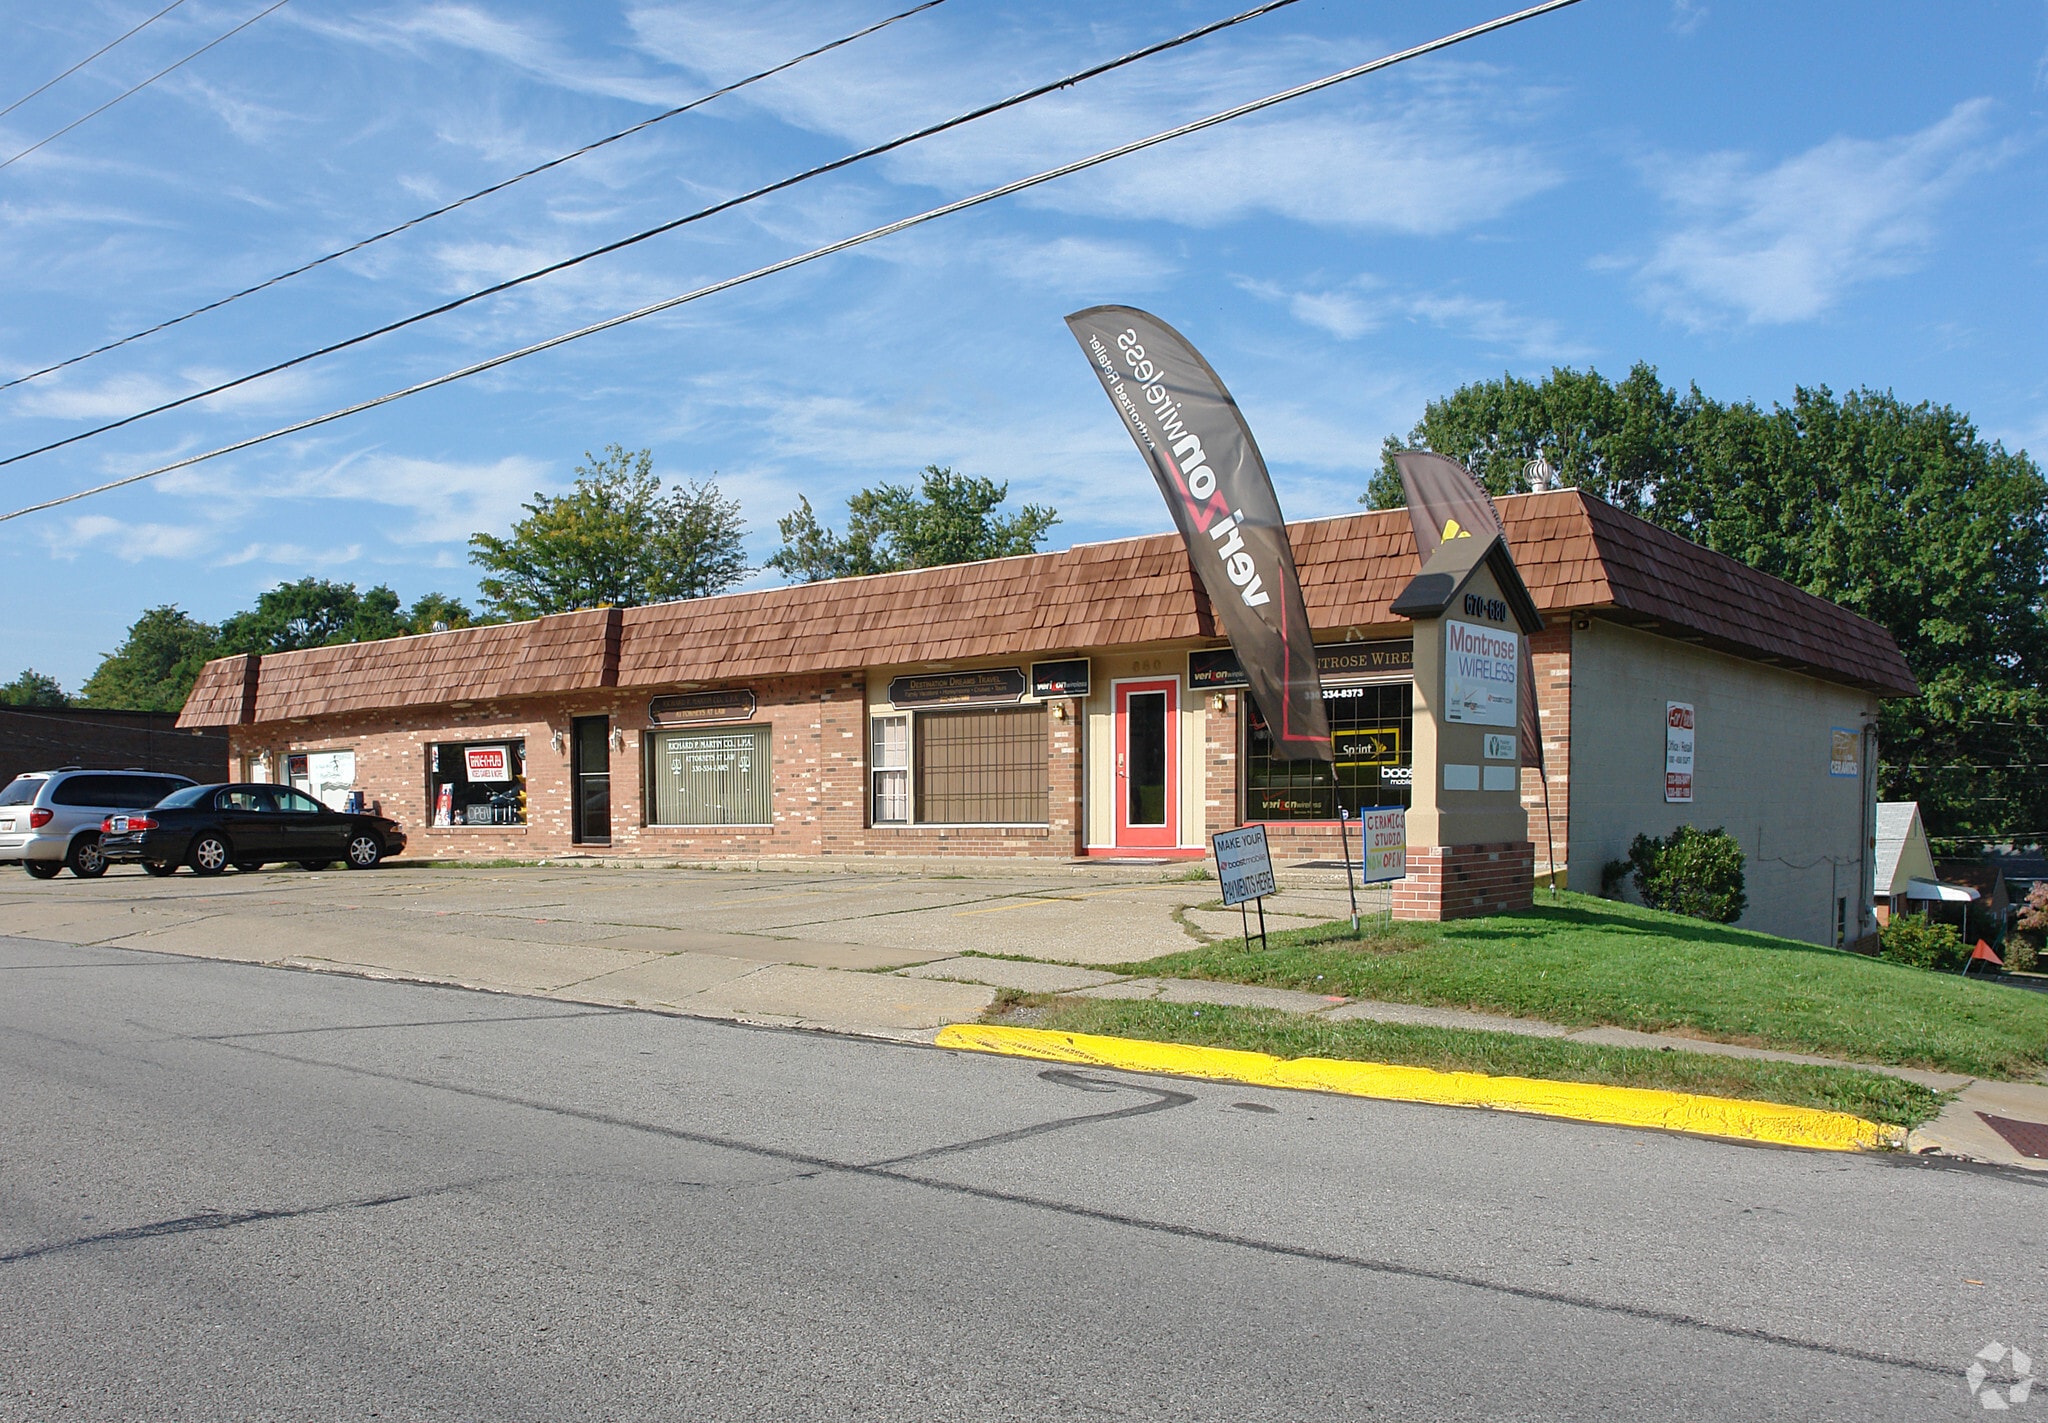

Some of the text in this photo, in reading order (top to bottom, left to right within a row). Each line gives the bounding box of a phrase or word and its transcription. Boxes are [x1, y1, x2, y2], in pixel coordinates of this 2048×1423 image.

[1465, 594, 1507, 622] 670-680
[1450, 624, 1515, 660] Montrose
[1459, 656, 1515, 683] WIRELESS
[1322, 688, 1364, 699] 334-8373
[1343, 744, 1373, 758] Sprint
[1381, 766, 1413, 778] boos
[467, 806, 492, 820] OPEN
[1367, 814, 1404, 831] CERAMICS
[1218, 833, 1263, 852] MAKE YOUR
[1375, 832, 1401, 846] STUDIO
[1383, 852, 1402, 868] OPEN
[1224, 871, 1273, 901] PAYMENTS HERE
